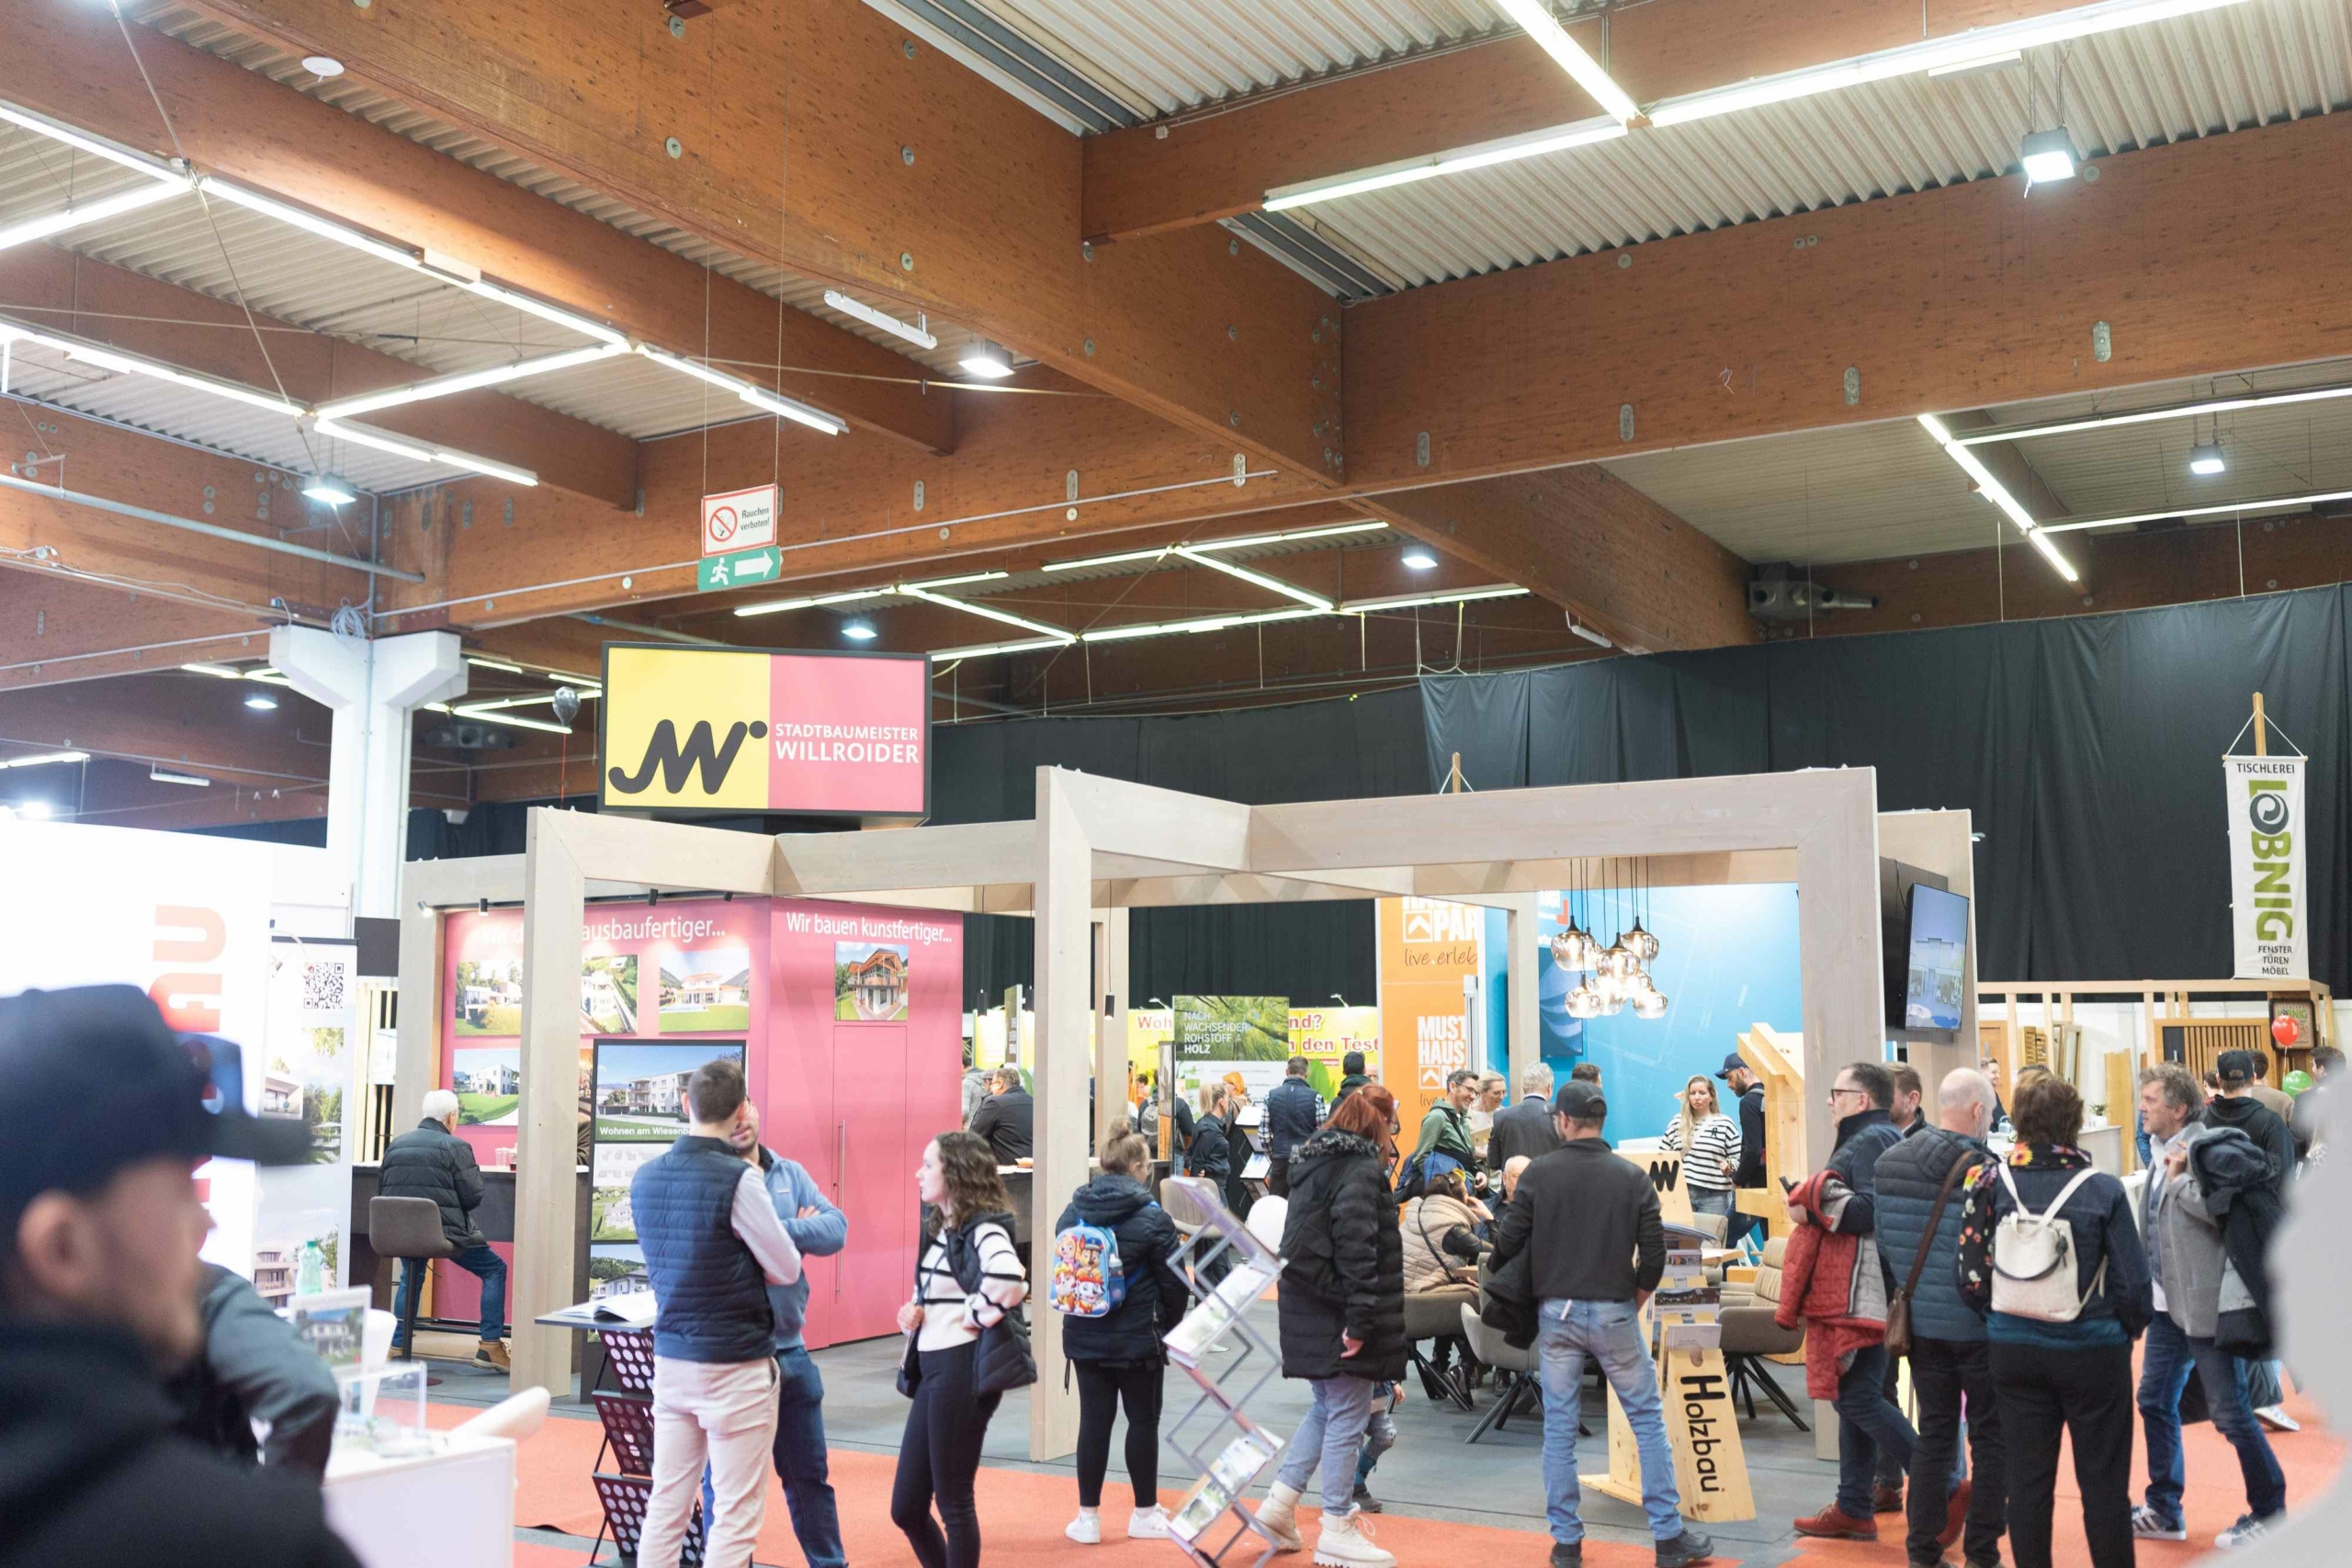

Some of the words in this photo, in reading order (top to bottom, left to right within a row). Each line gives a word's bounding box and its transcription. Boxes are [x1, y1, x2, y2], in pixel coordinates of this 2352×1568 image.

[742, 507, 769, 519] Rauchen
[740, 517, 770, 531] verboten!
[775, 723, 919, 741] STADTBAUMEISTER
[775, 740, 920, 763] WILLROIDER
[2236, 762, 2295, 774] TISCHLEREI
[582, 916, 726, 944] ausbaufertiger...
[786, 912, 811, 931] Wir
[814, 913, 858, 935] bauen
[862, 917, 953, 945] kunstfertiger...
[2258, 945, 2293, 954] FENSTER
[2263, 954, 2290, 964] TÜREN
[2262, 964, 2290, 976] MÖBEL
[1184, 1011, 1215, 1021] NACH-
[1184, 1022, 1248, 1032] WACHSENDER
[1184, 1033, 1233, 1043] ROHSTOFF
[1303, 1037, 1334, 1051] den
[1184, 1044, 1211, 1055] HOLZ
[1419, 1041, 1467, 1065] HAUS
[600, 1126, 635, 1135] Wohnen
[1680, 1374, 1726, 1492] Holzbau
